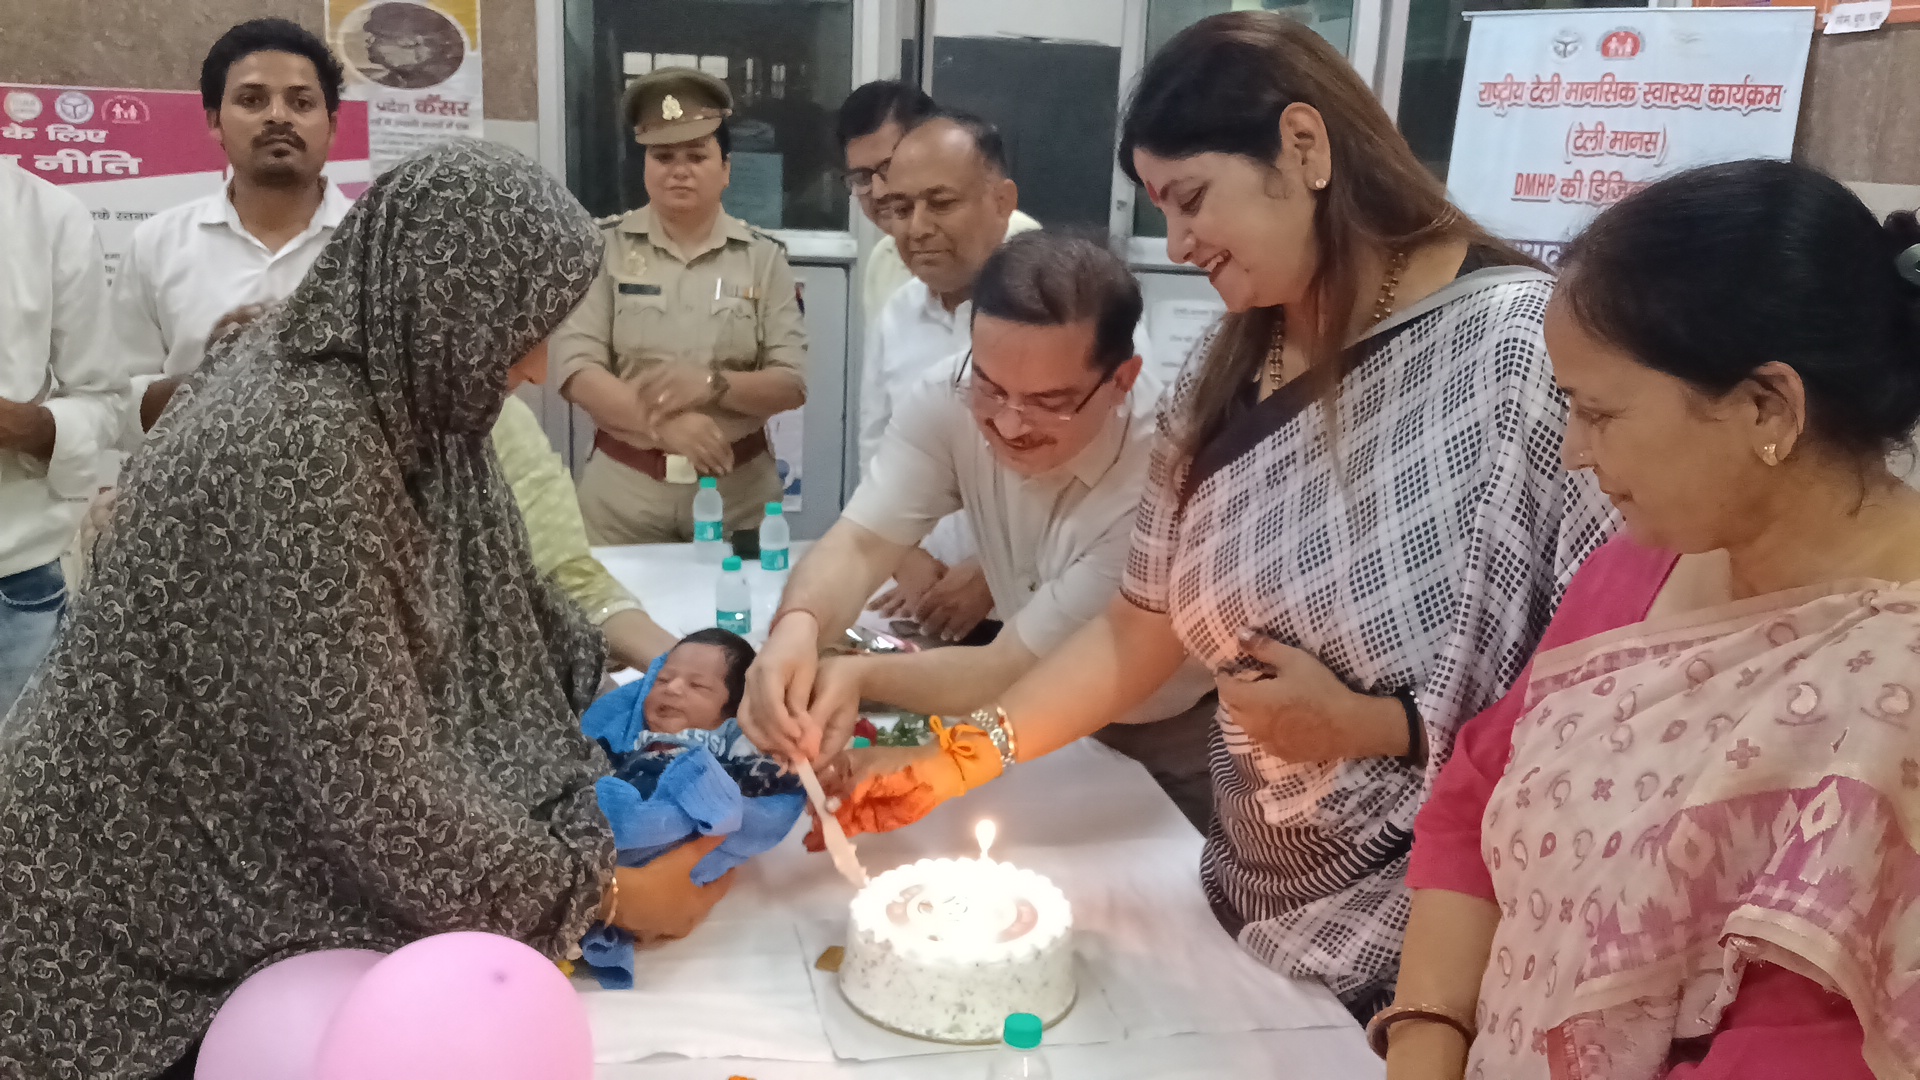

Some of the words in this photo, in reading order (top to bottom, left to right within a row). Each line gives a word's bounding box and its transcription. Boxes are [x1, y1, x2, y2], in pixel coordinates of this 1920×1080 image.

[1478, 73, 1526, 111] राष्ट्रीय
[1529, 73, 1561, 103] टेली
[1565, 72, 1639, 104] मानसिक
[1643, 82, 1704, 106] स्वास्थ्य
[1707, 74, 1784, 111] कार्यक्रम
[46, 123, 109, 143] लिए
[34, 148, 142, 175] नीति
[1514, 172, 1556, 197] DMHP
[1559, 169, 1585, 199] की
